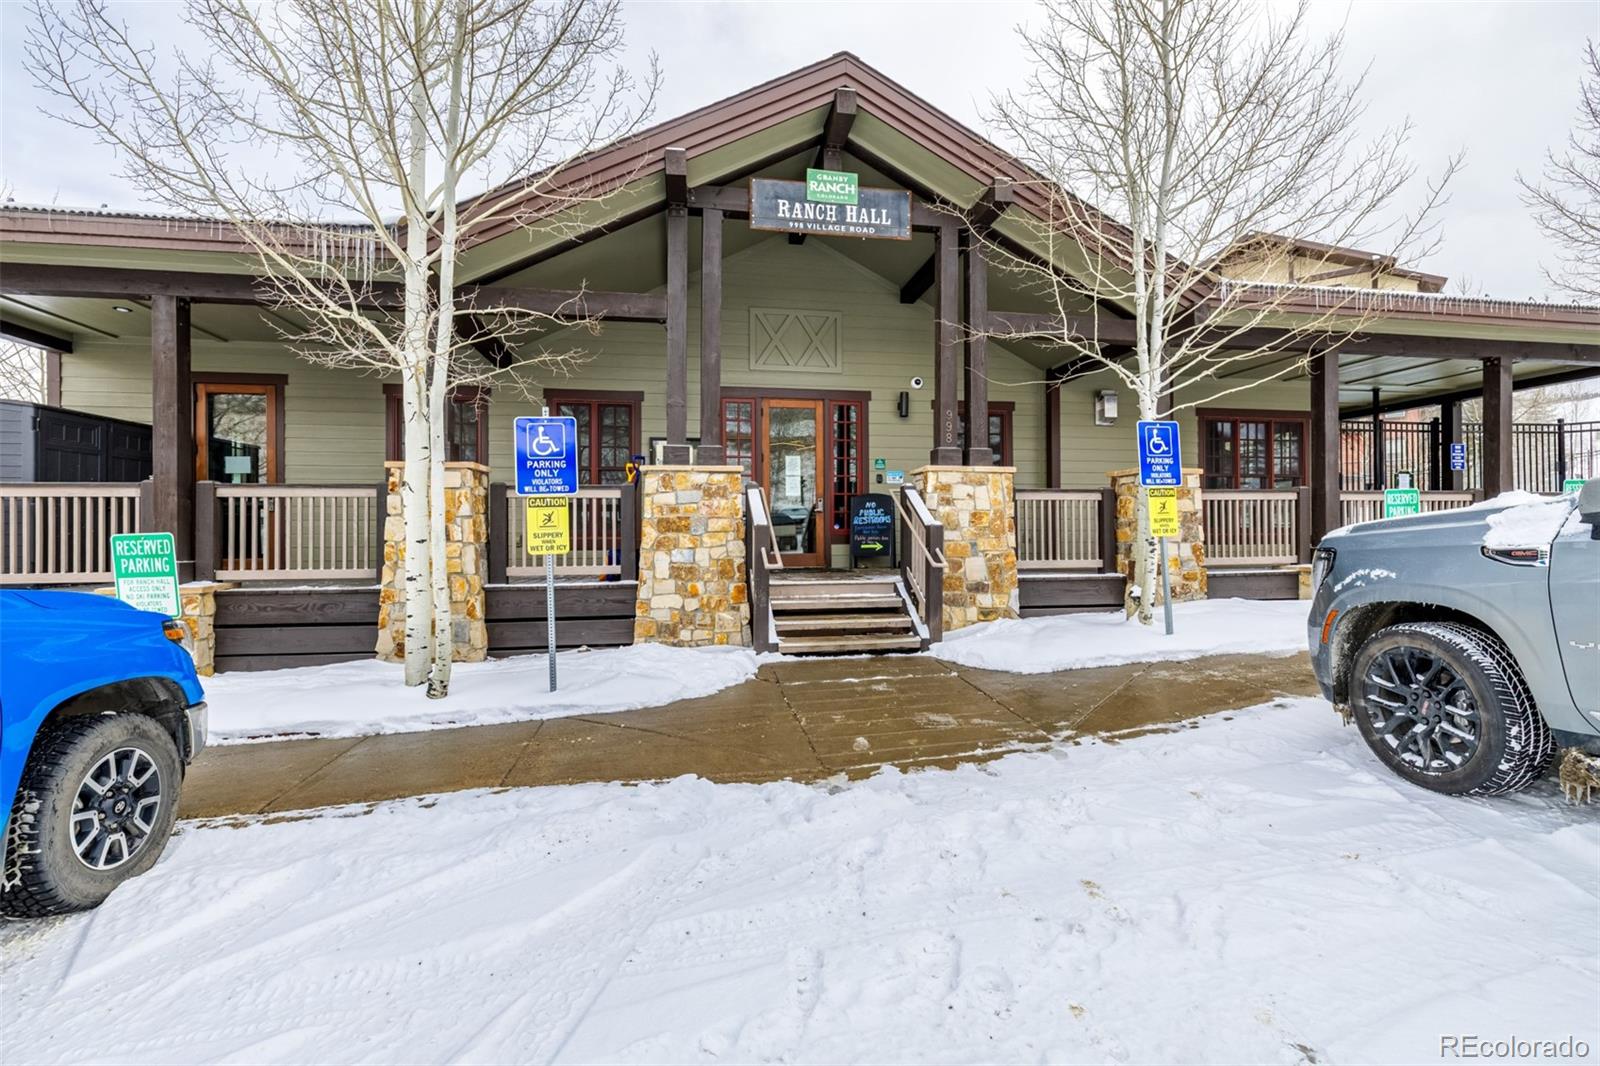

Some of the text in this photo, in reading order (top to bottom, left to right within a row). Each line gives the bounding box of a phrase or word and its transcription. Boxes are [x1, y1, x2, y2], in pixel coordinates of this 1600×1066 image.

[816, 173, 848, 182] GRANBY
[809, 180, 857, 194] RANCH
[777, 199, 892, 225] RANCH HALL
[806, 223, 846, 232] VILLAGE
[850, 226, 876, 234] ROAD
[527, 460, 566, 468] PARKING
[534, 469, 559, 477] ONLY
[530, 498, 566, 506] CAUTION
[1387, 493, 1417, 504] RESERVED
[859, 508, 885, 516] PUBLIC
[853, 515, 891, 525] RESTROOMS
[115, 539, 171, 556] RESERVED
[120, 557, 170, 574] PARKING
